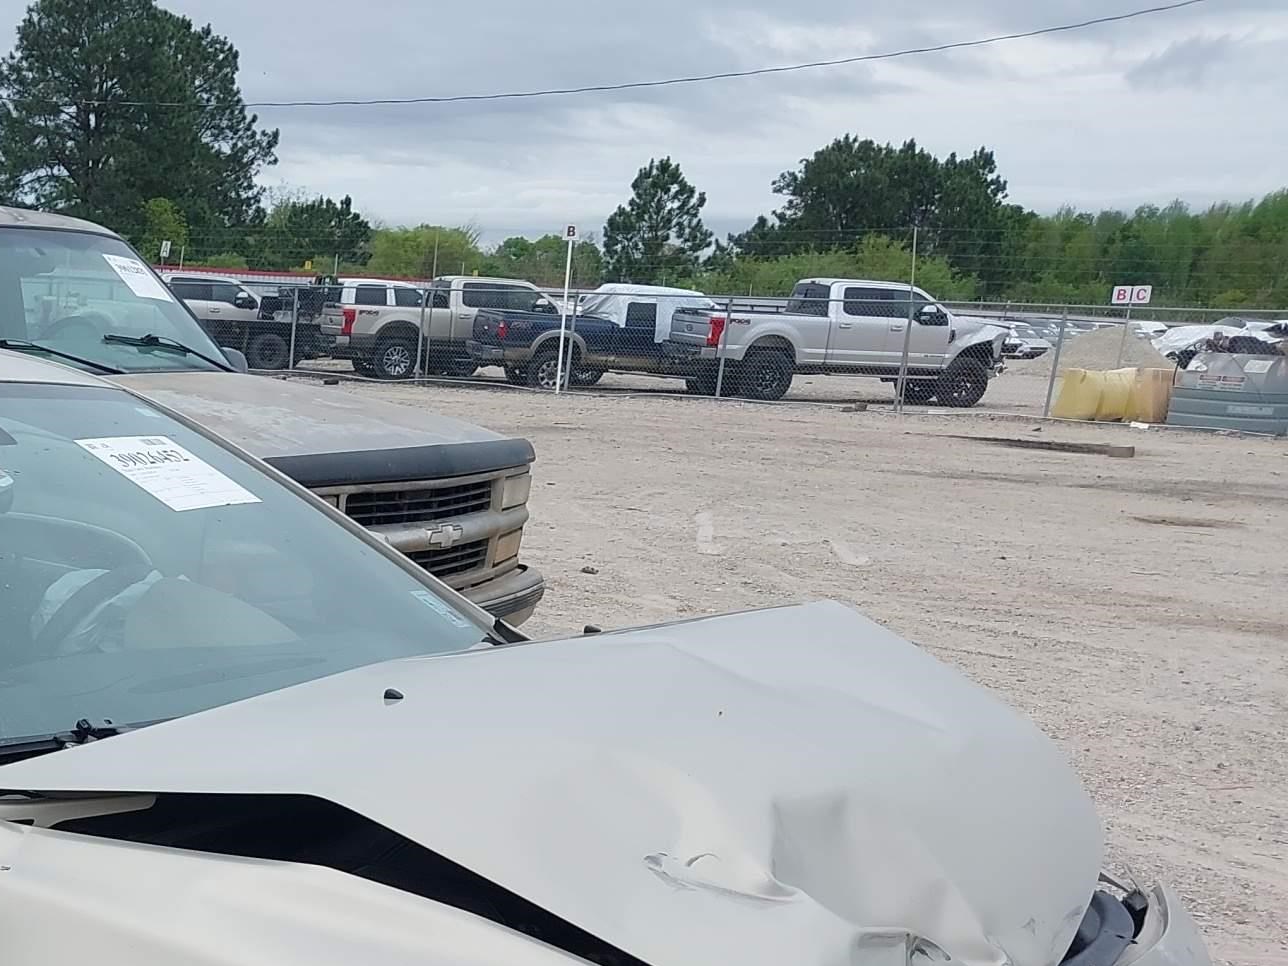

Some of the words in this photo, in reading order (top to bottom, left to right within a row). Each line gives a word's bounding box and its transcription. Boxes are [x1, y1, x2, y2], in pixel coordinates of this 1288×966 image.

[567, 225, 576, 237] B
[1116, 288, 1127, 301] B
[1136, 288, 1147, 301] C
[109, 449, 190, 468] 39026452
